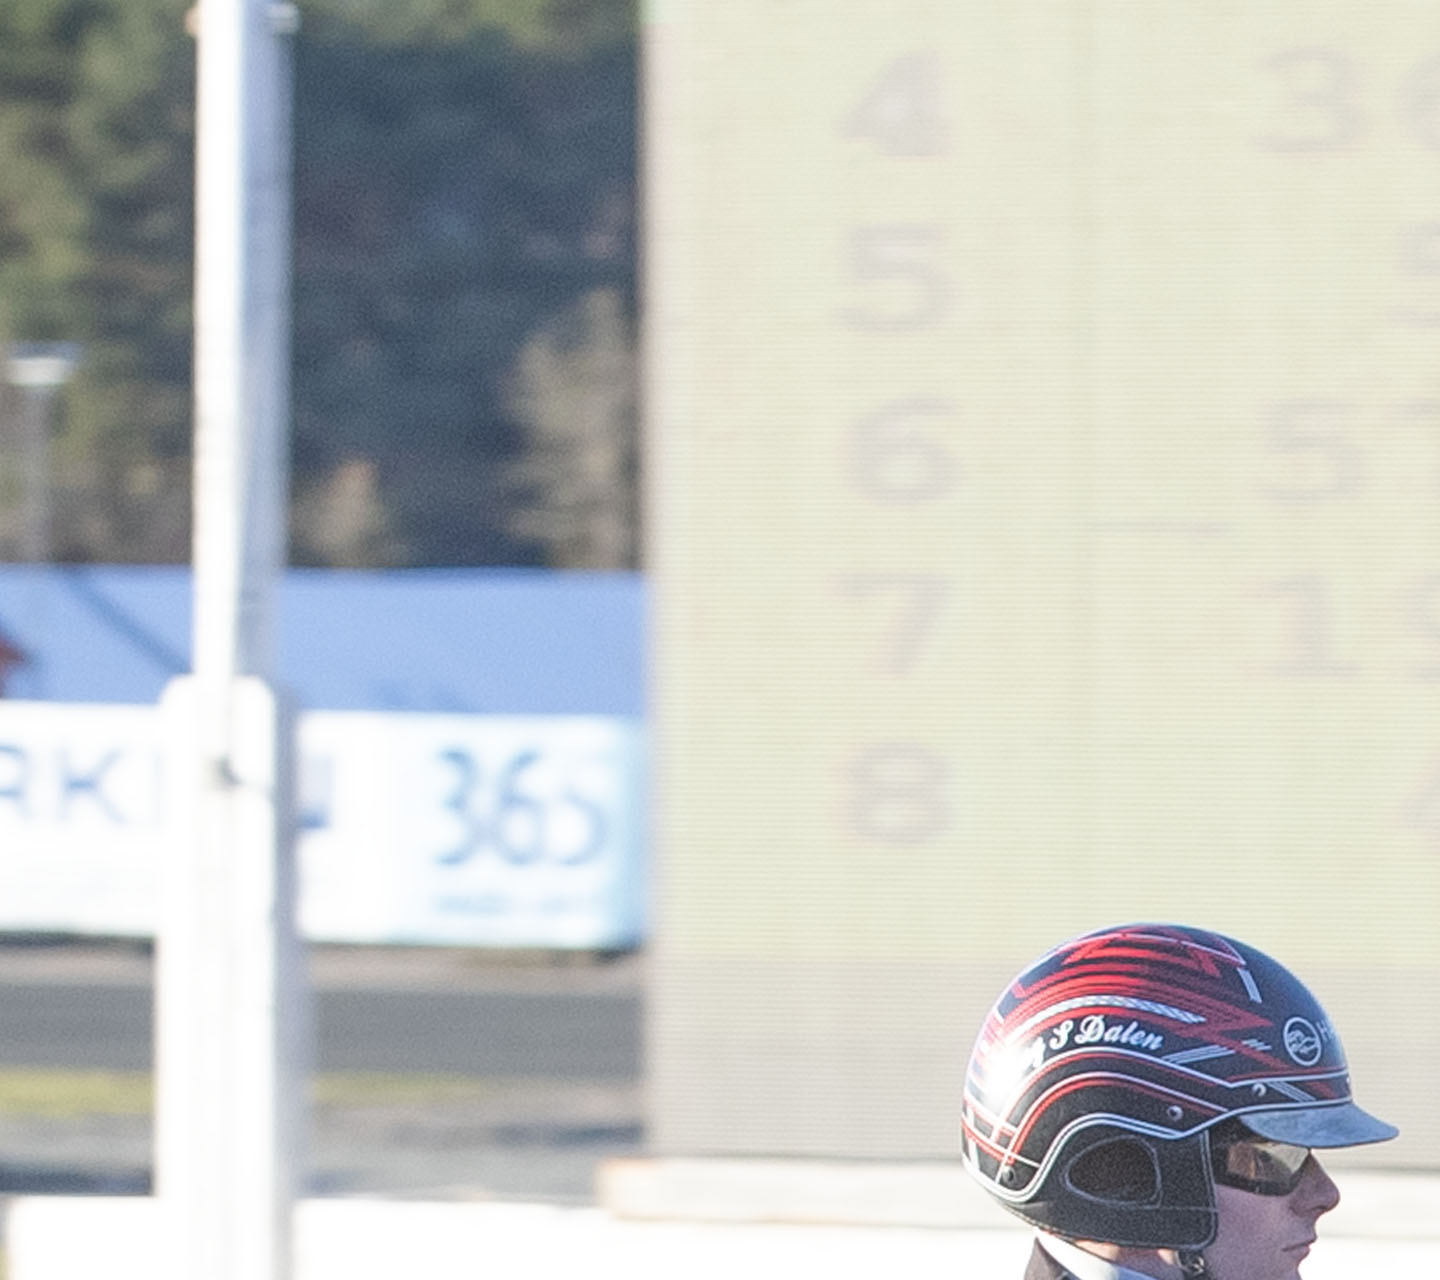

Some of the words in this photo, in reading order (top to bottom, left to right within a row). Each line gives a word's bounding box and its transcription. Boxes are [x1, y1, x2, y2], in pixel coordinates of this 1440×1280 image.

[836, 50, 952, 158] 4
[834, 223, 954, 333] 5
[842, 396, 960, 506] 6
[838, 568, 954, 676] 7
[838, 740, 954, 849] 8
[1076, 1014, 1164, 1050] Dalen
